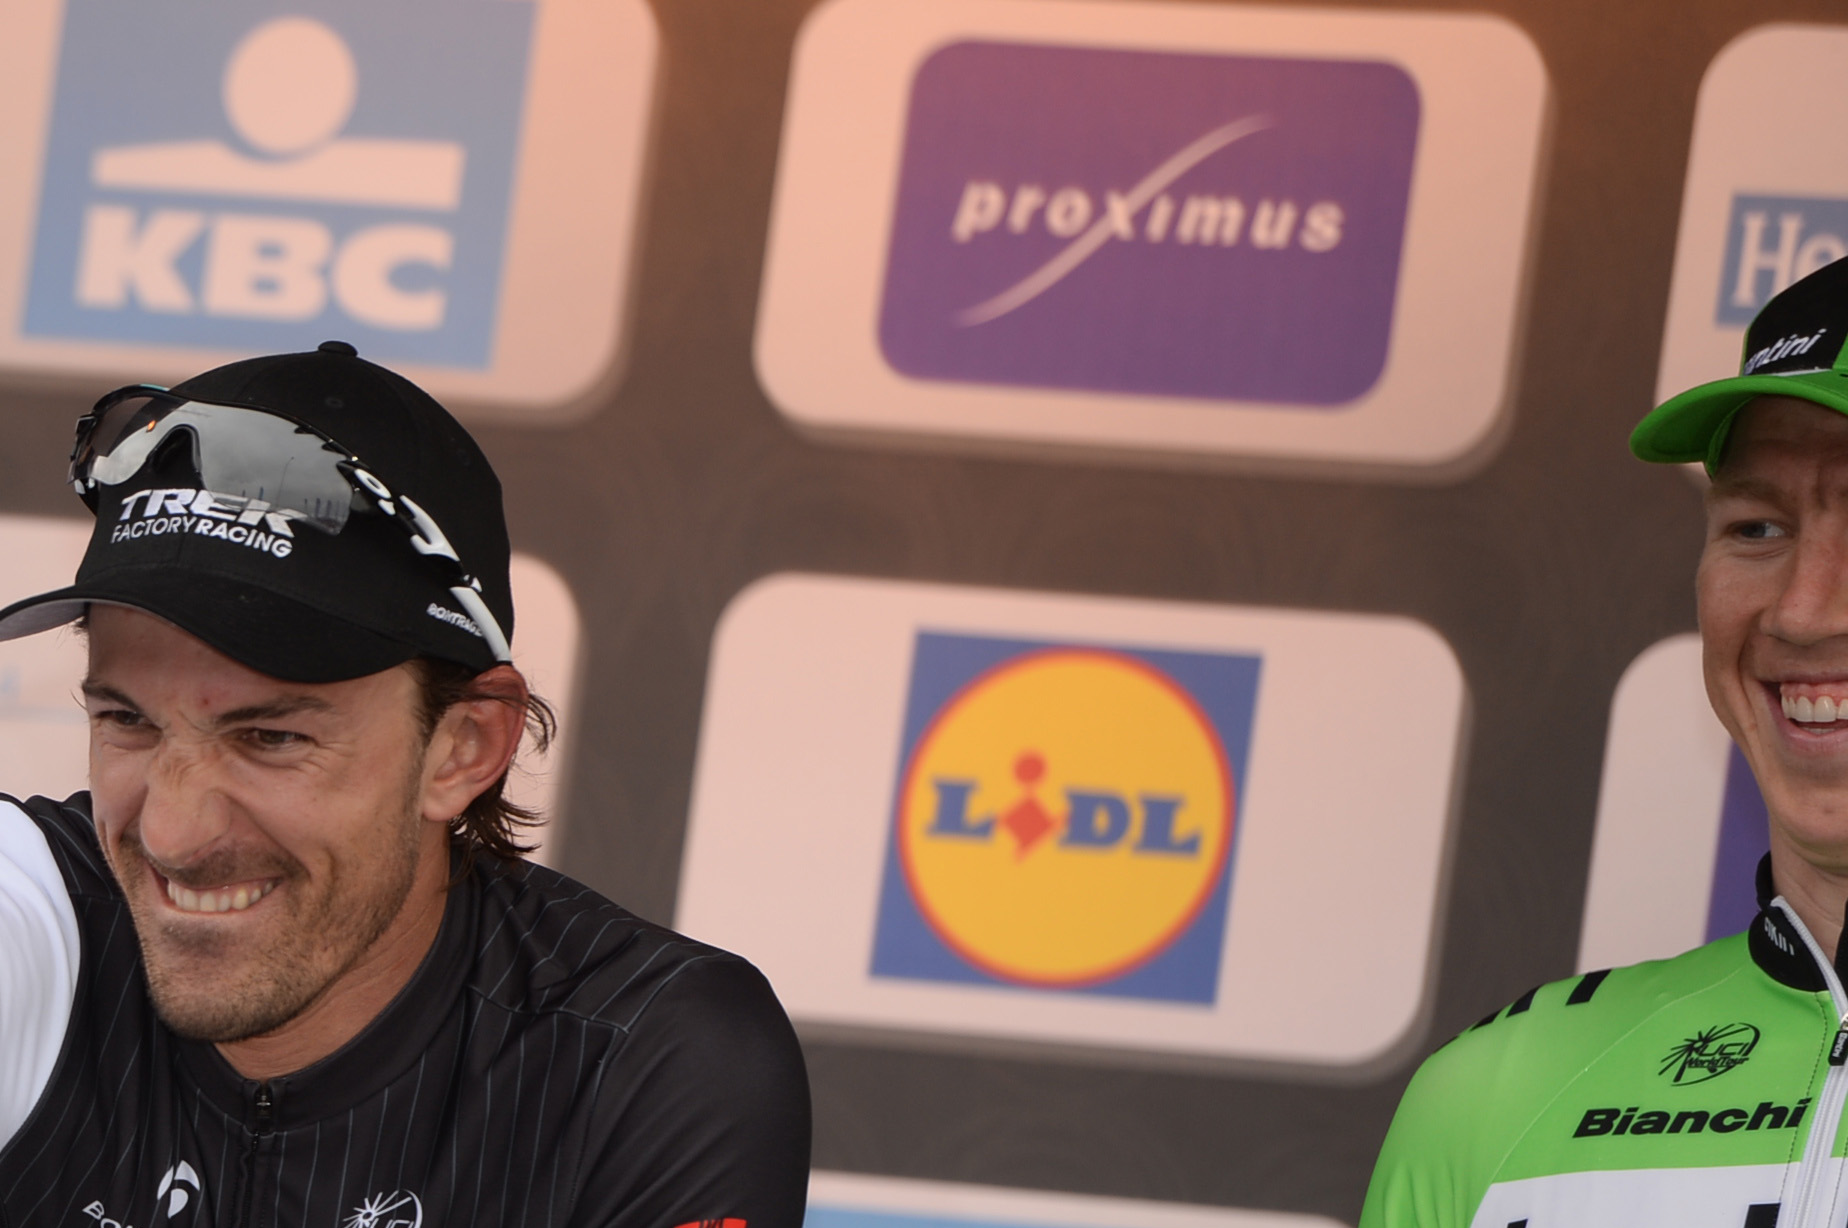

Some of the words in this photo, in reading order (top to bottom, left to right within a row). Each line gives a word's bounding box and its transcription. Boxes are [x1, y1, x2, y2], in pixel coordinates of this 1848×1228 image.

[953, 178, 1345, 252] proximus
[75, 205, 455, 331] KBC
[110, 516, 196, 544] FACTORY
[194, 518, 293, 558] RACING
[119, 488, 307, 538] TREK
[1572, 1097, 1812, 1140] Bianchi
